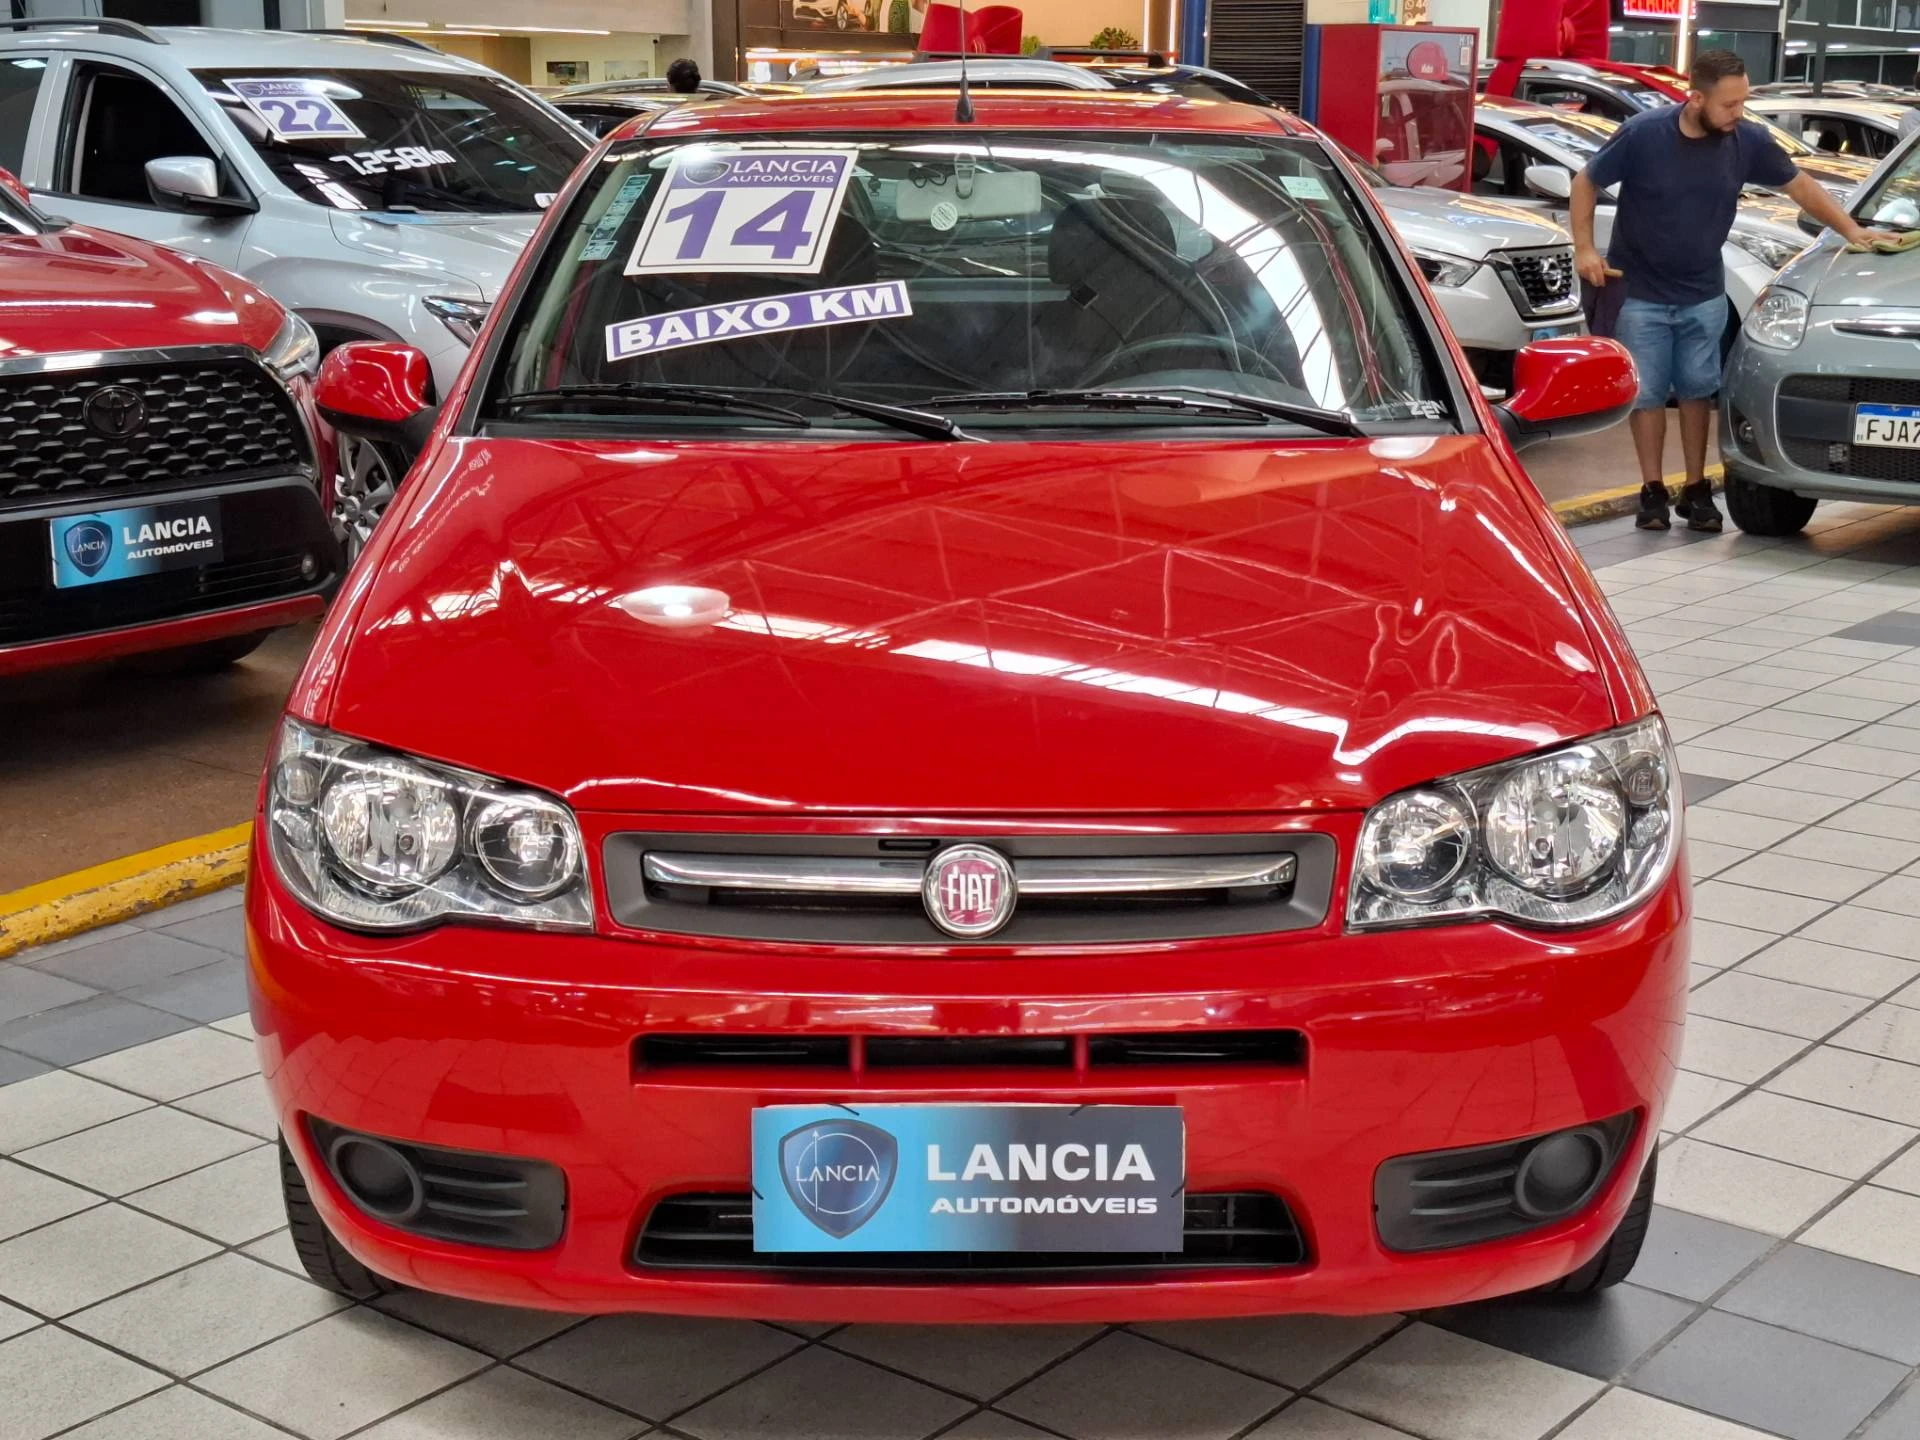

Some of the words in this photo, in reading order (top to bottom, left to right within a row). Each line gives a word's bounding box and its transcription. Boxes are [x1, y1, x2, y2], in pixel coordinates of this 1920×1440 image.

[259, 100, 347, 132] 22
[728, 173, 835, 183] AUTOMÓVEIS
[732, 160, 837, 174] LANCIA
[665, 190, 816, 260] 14
[618, 301, 790, 354] BAIXO
[810, 286, 898, 321] KM
[1867, 419, 1920, 442] FJA7
[123, 515, 212, 545] LANCIA
[71, 540, 105, 553] LANCIA
[127, 539, 214, 560] AUTOMÓVEIS
[947, 865, 996, 913] FIAT
[795, 1163, 880, 1182] LANCIA
[927, 1143, 1156, 1182] LANCIA
[930, 1195, 1158, 1214] AUTOMÓVEIS
